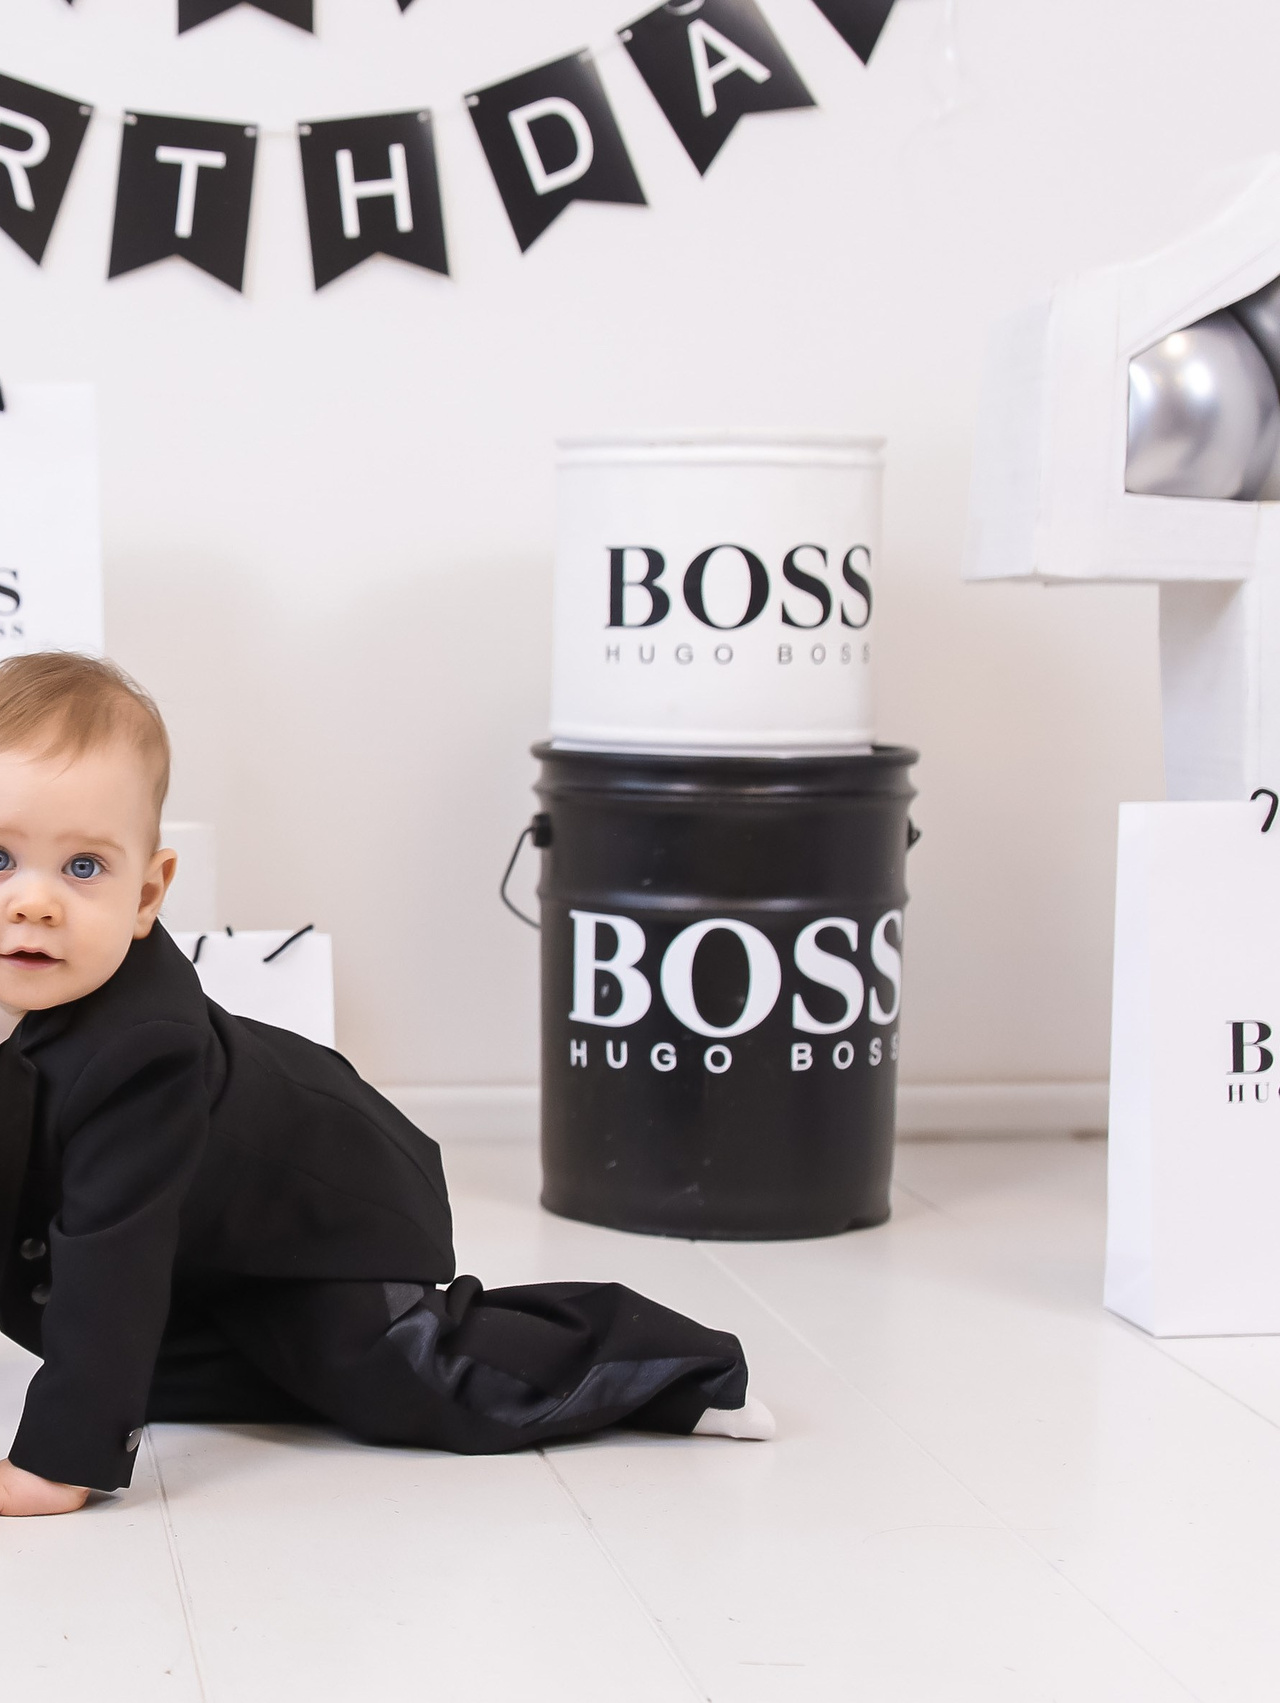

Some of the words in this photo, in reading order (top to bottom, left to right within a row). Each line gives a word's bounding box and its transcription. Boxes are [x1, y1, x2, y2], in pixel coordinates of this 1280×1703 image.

[604, 543, 874, 630] BOSS
[604, 643, 734, 665] HUGO
[777, 641, 872, 665] BOSS
[568, 909, 904, 1038] BOSS
[569, 1039, 733, 1074] HUGO
[791, 1031, 900, 1072] BOSS
